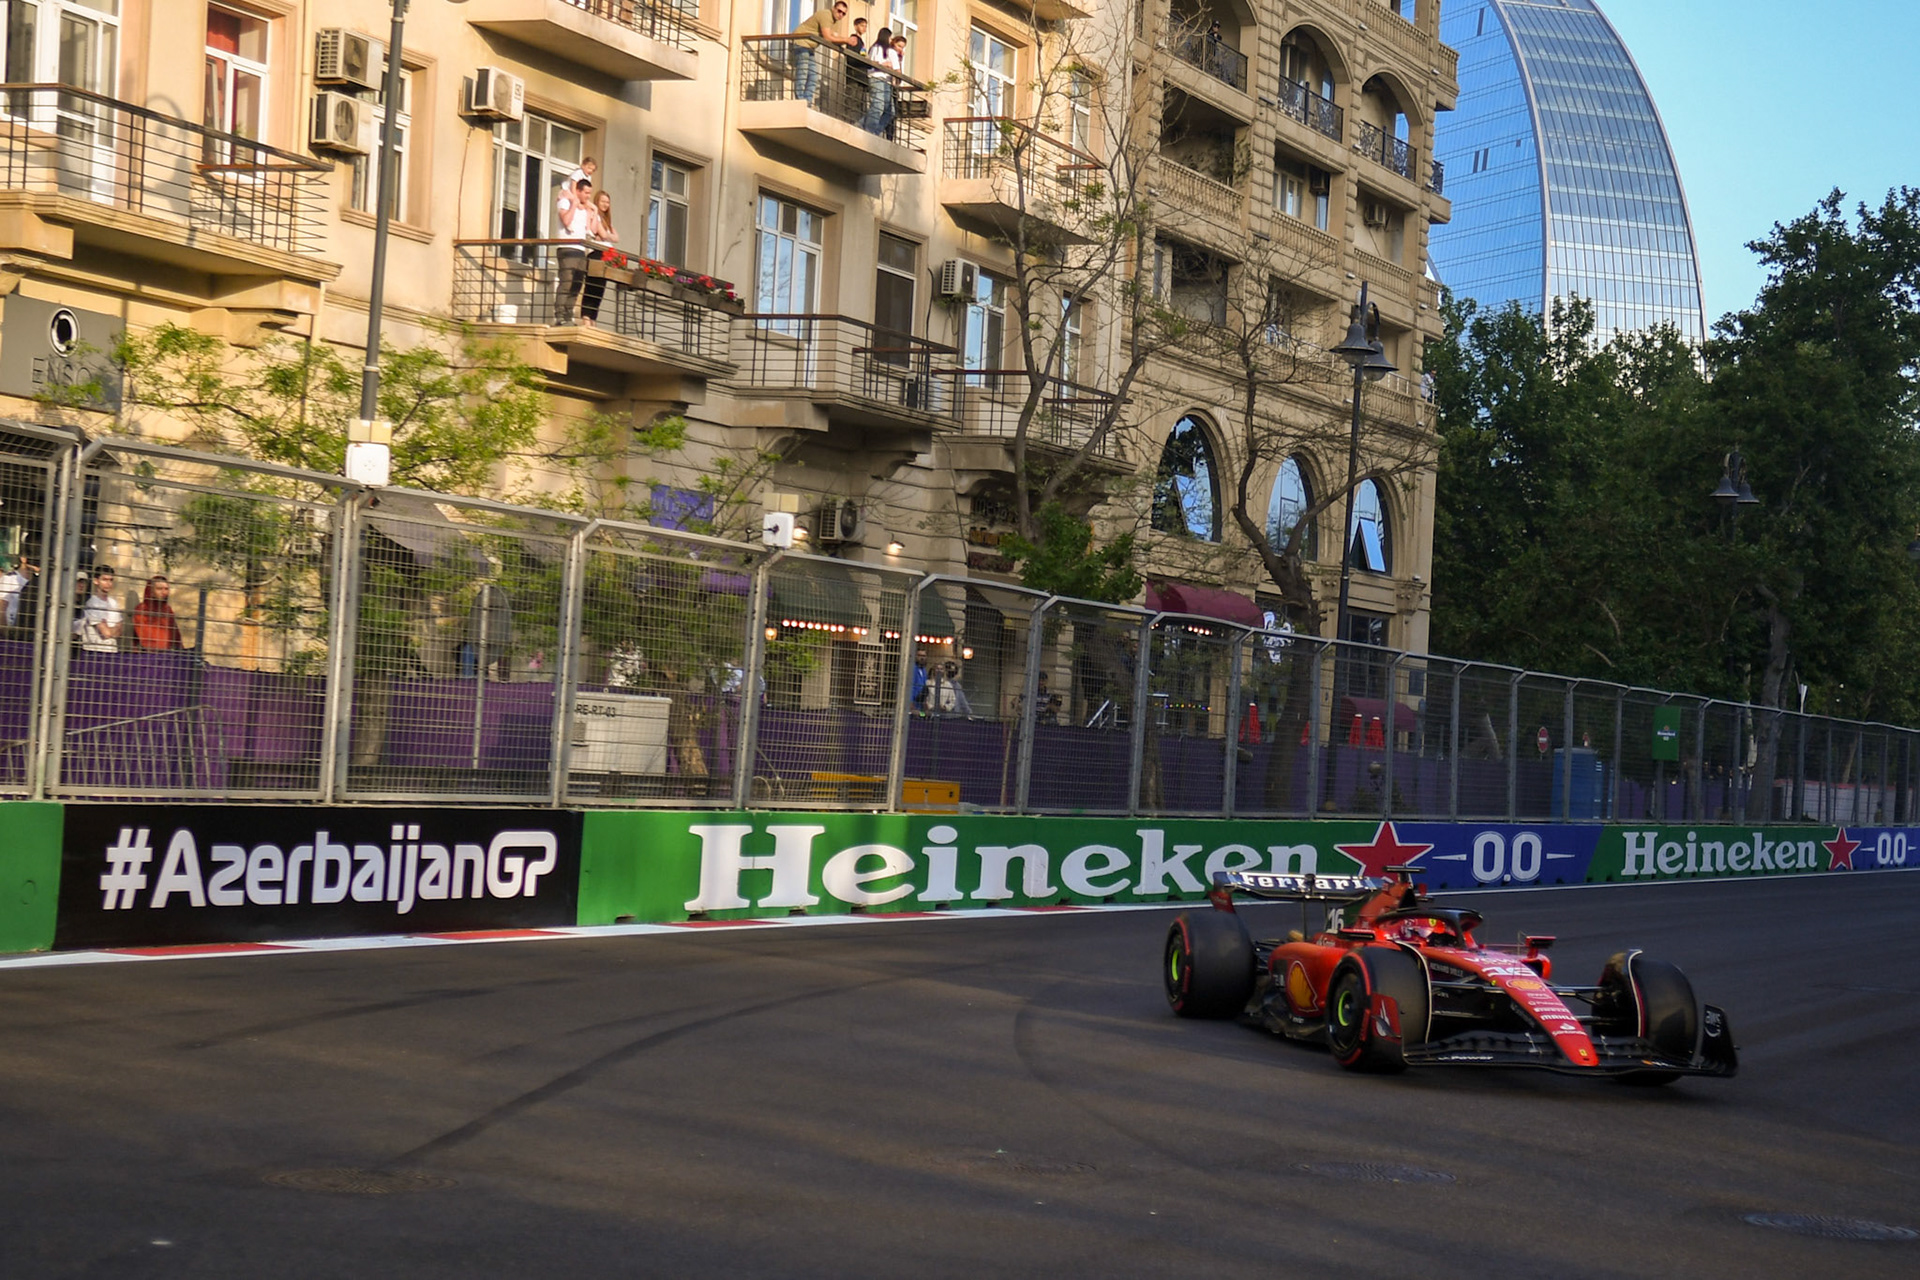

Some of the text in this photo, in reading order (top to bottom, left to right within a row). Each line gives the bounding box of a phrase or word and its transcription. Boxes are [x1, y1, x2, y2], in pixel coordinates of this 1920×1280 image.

[32, 356, 92, 389] ENSO
[100, 824, 558, 914] #AzerbaijanGP
[684, 823, 1318, 912] Heineken
[1621, 831, 1818, 876] Heineken
[1241, 872, 1364, 891] Ferrari
[1326, 908, 1344, 934] 16
